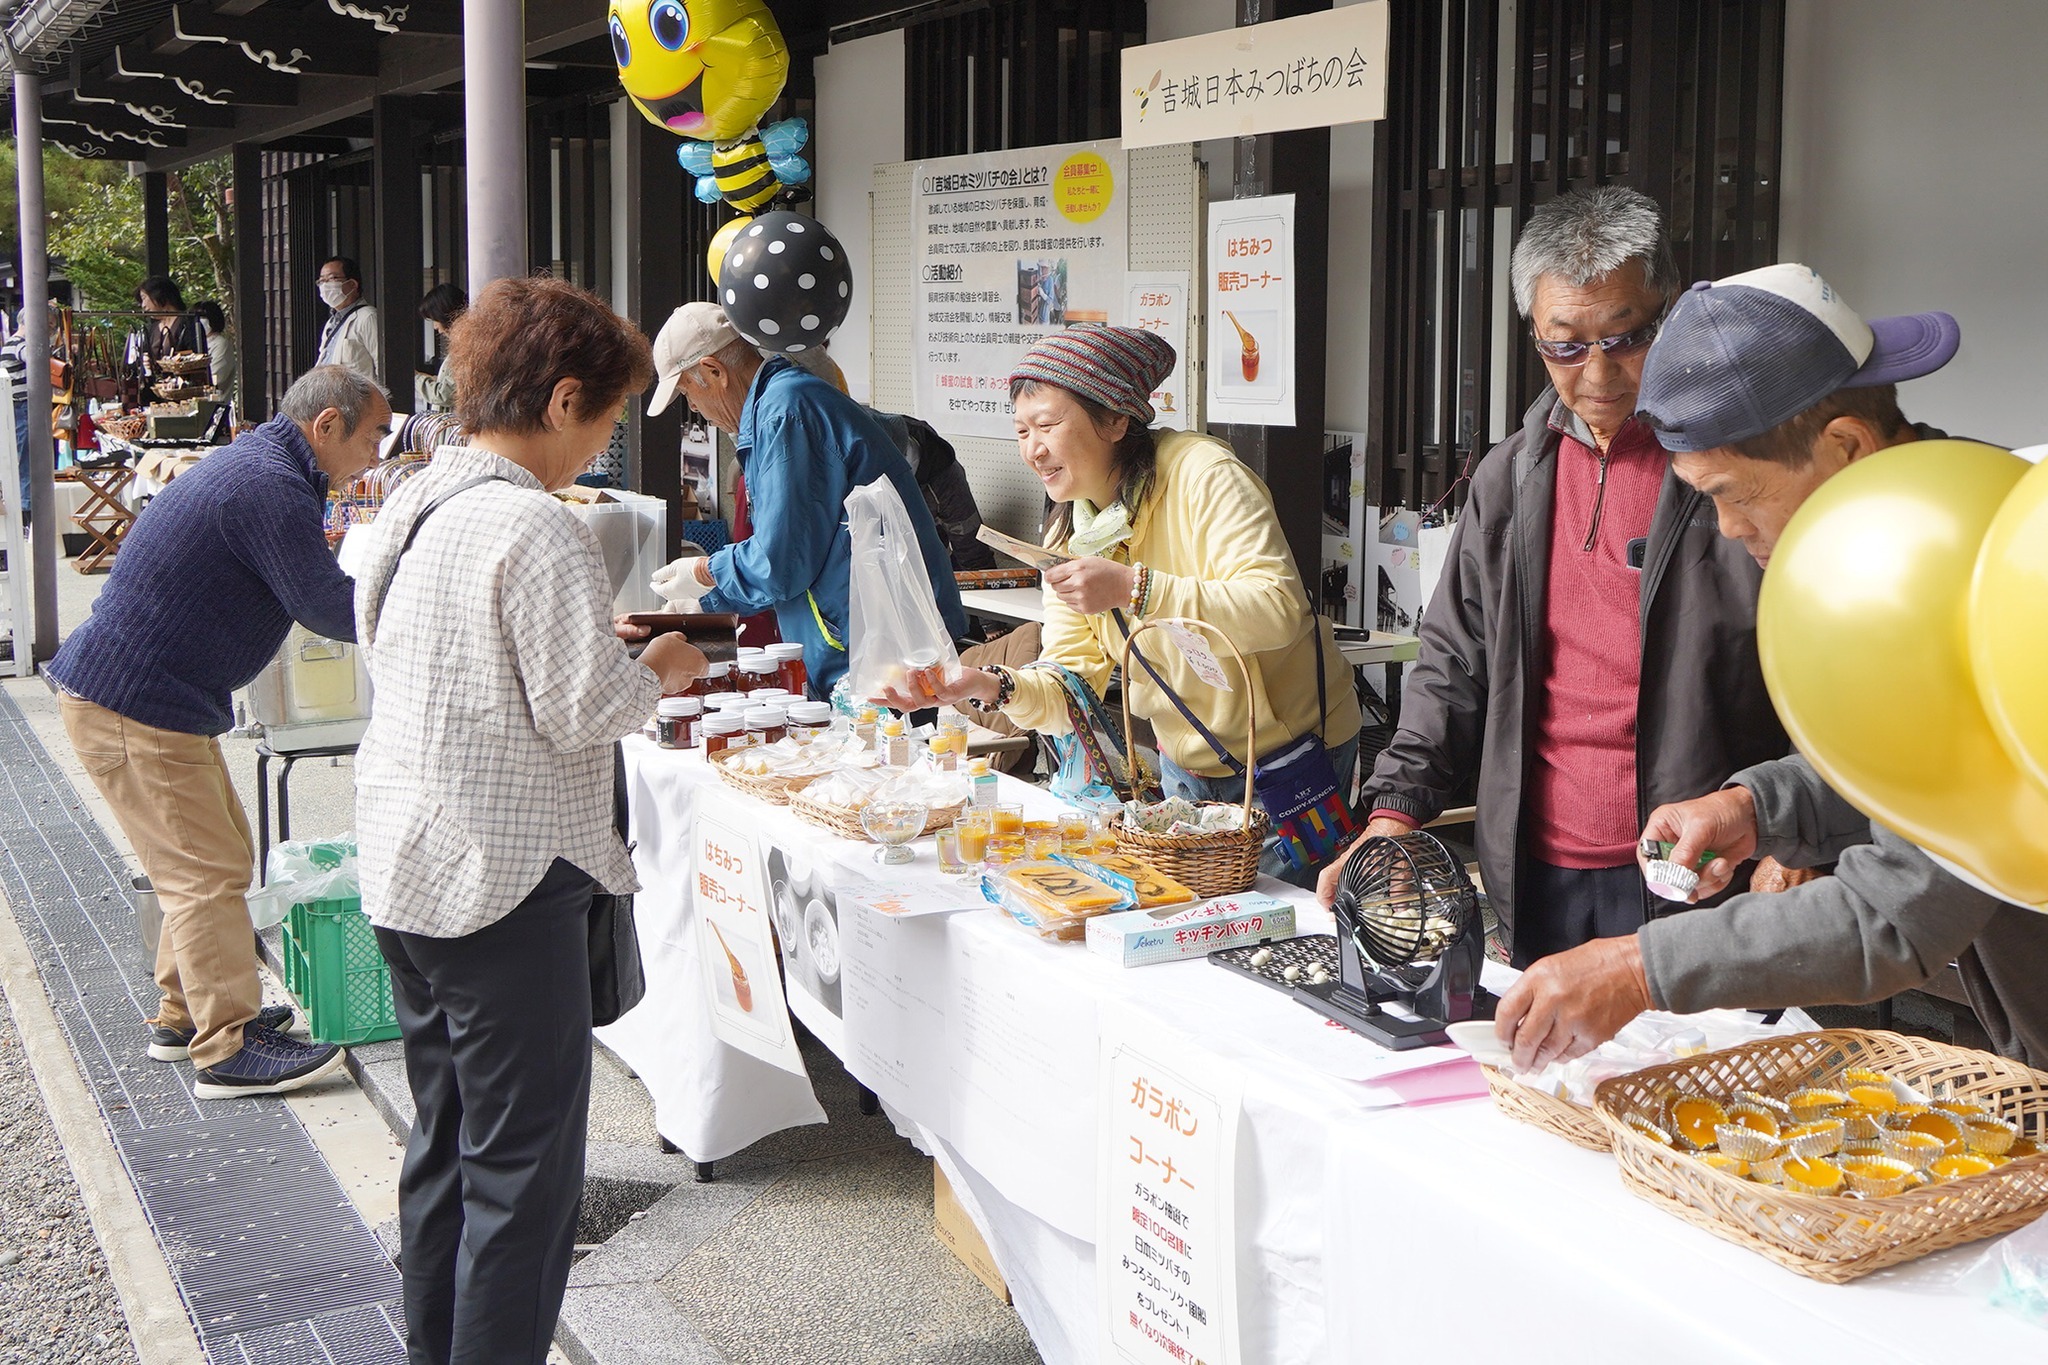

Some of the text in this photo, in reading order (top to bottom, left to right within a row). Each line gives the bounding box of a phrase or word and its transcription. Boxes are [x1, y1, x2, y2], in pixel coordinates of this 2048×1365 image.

[1161, 47, 1367, 114] 吉城日本みつばちの会
[1063, 162, 1102, 178] 会員募集中！
[1067, 185, 1100, 196] 私たちと一緒に
[1227, 236, 1273, 258] はちみつ
[1140, 292, 1171, 307] ガラポン
[1218, 271, 1282, 292] 販売コーナー
[1139, 319, 1170, 330] コーナー
[928, 351, 961, 363] 行っています。
[704, 838, 743, 875] はちみつ
[699, 872, 757, 914] 販売コーナー
[1174, 916, 1264, 945] キッチンパック
[1130, 1075, 1198, 1137] ガラポン
[1129, 1135, 1195, 1191] コーナー
[1134, 1182, 1190, 1231] ガラポン抽選で
[1134, 1234, 1191, 1286] 日本ミツバチの
[1121, 1254, 1207, 1327] みつろうローソク・風船
[1137, 1291, 1191, 1339] をプレゼント！
[1129, 1310, 1195, 1365] 無くなり次第終了
